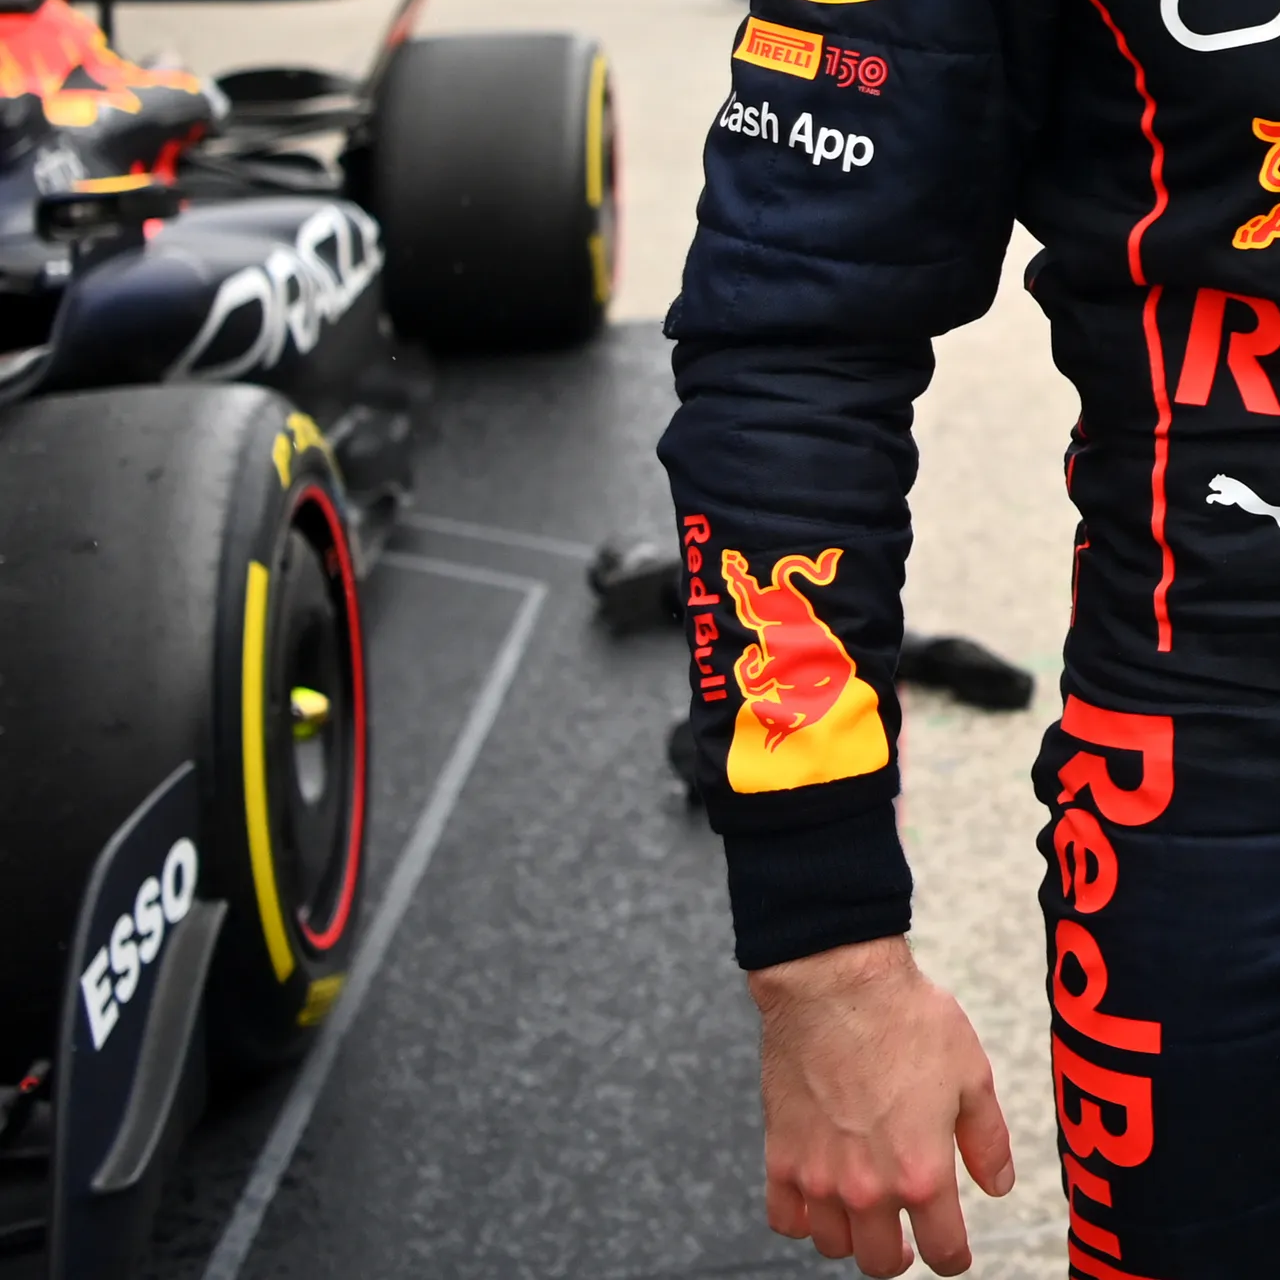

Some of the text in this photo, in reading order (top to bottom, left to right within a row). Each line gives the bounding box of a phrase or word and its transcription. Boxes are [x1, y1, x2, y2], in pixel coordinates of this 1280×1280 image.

[746, 27, 889, 88] PIRELLI 150
[788, 112, 875, 173] App
[683, 513, 728, 703] Red Bull
[80, 836, 198, 1051] ESSO
[1052, 693, 1175, 1055] Red
